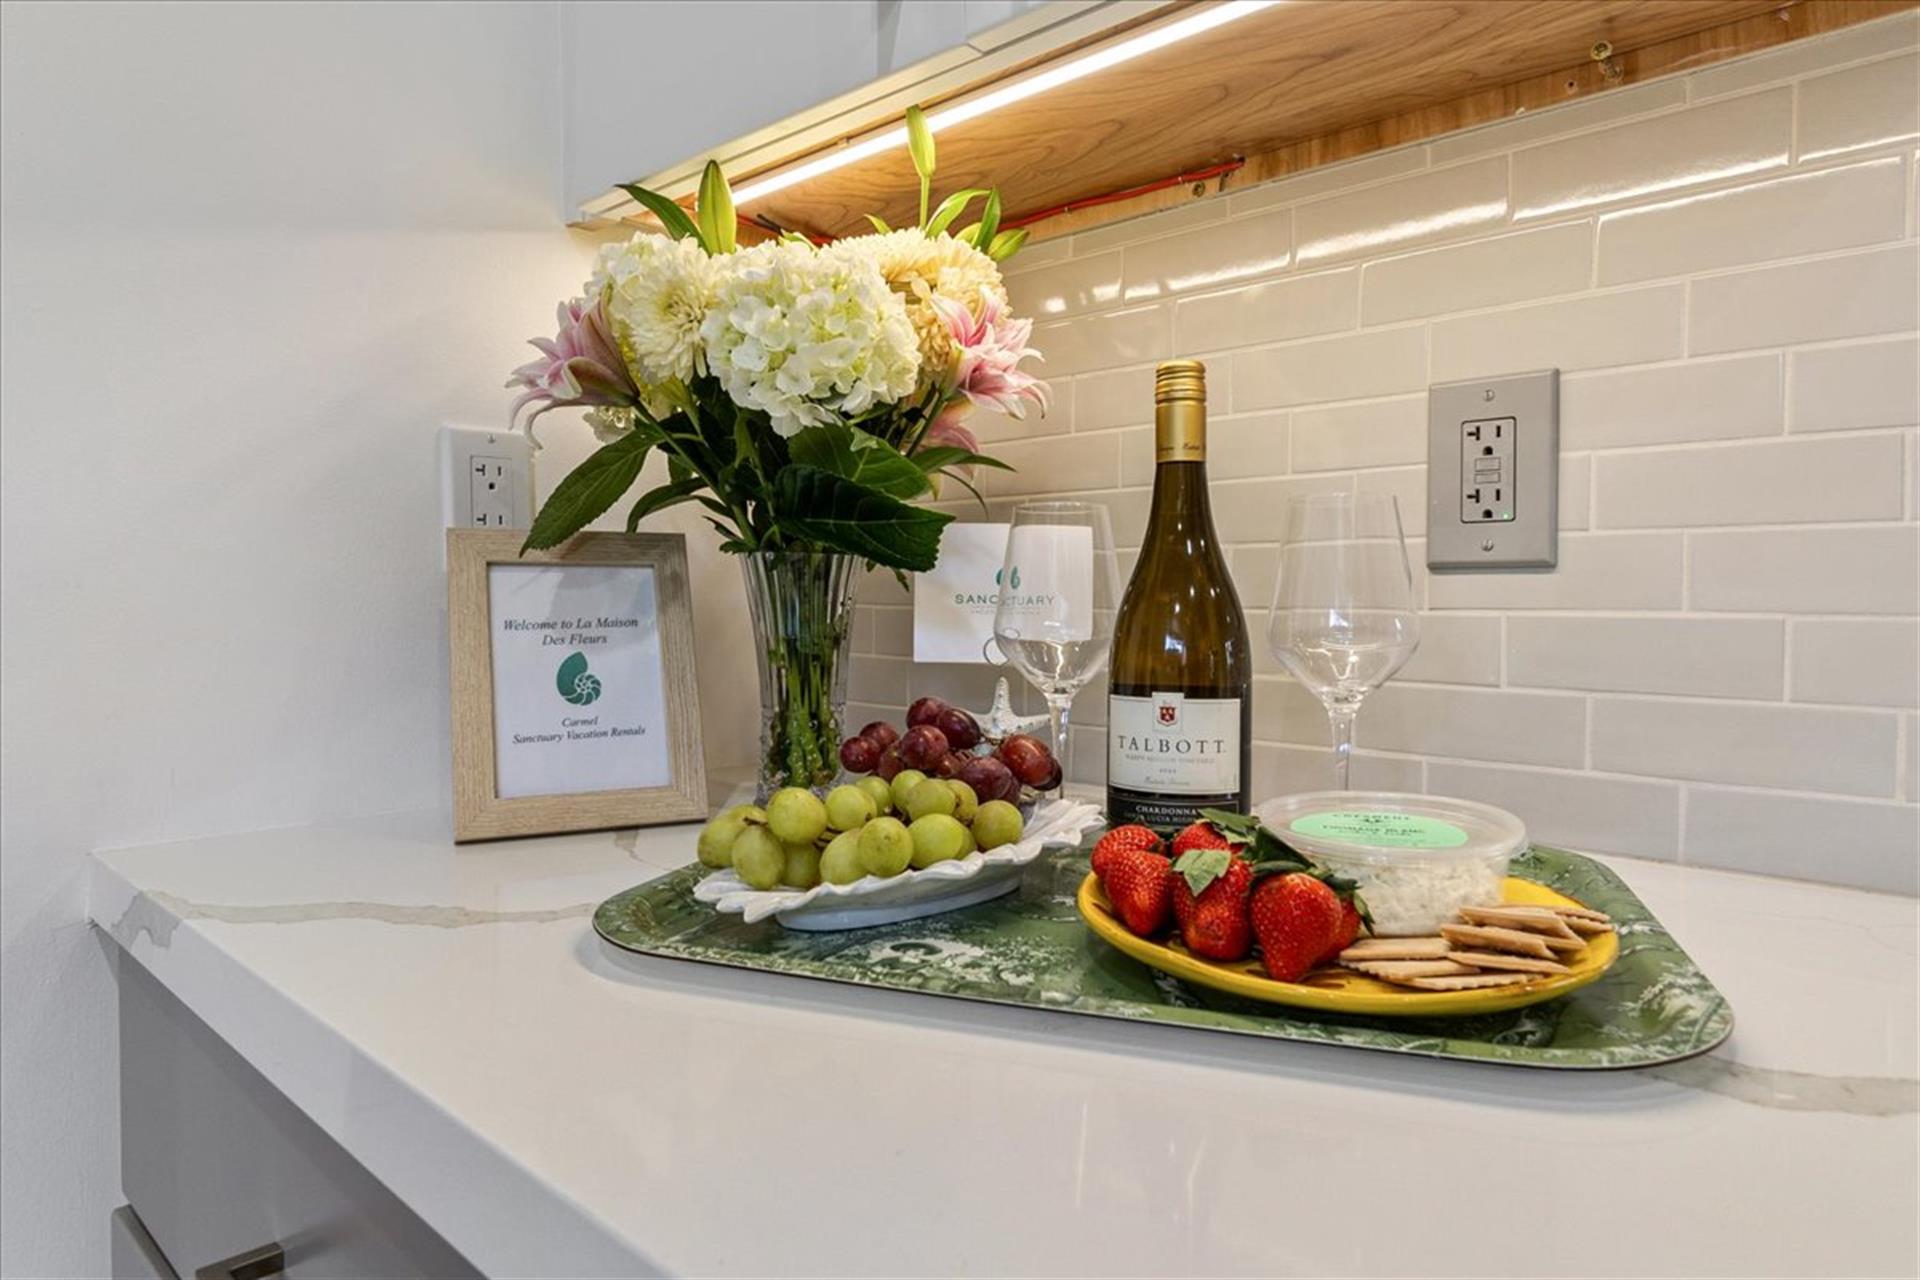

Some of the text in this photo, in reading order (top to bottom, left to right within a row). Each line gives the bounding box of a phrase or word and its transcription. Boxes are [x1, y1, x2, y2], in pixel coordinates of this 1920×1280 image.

[503, 617, 639, 631] Welcome to La Maison
[542, 633, 608, 646] Des Fleurs
[561, 716, 599, 728] Carmel
[512, 726, 646, 745] Sanctuary Vacation Rentals
[1117, 735, 1225, 755] TALBOTT
